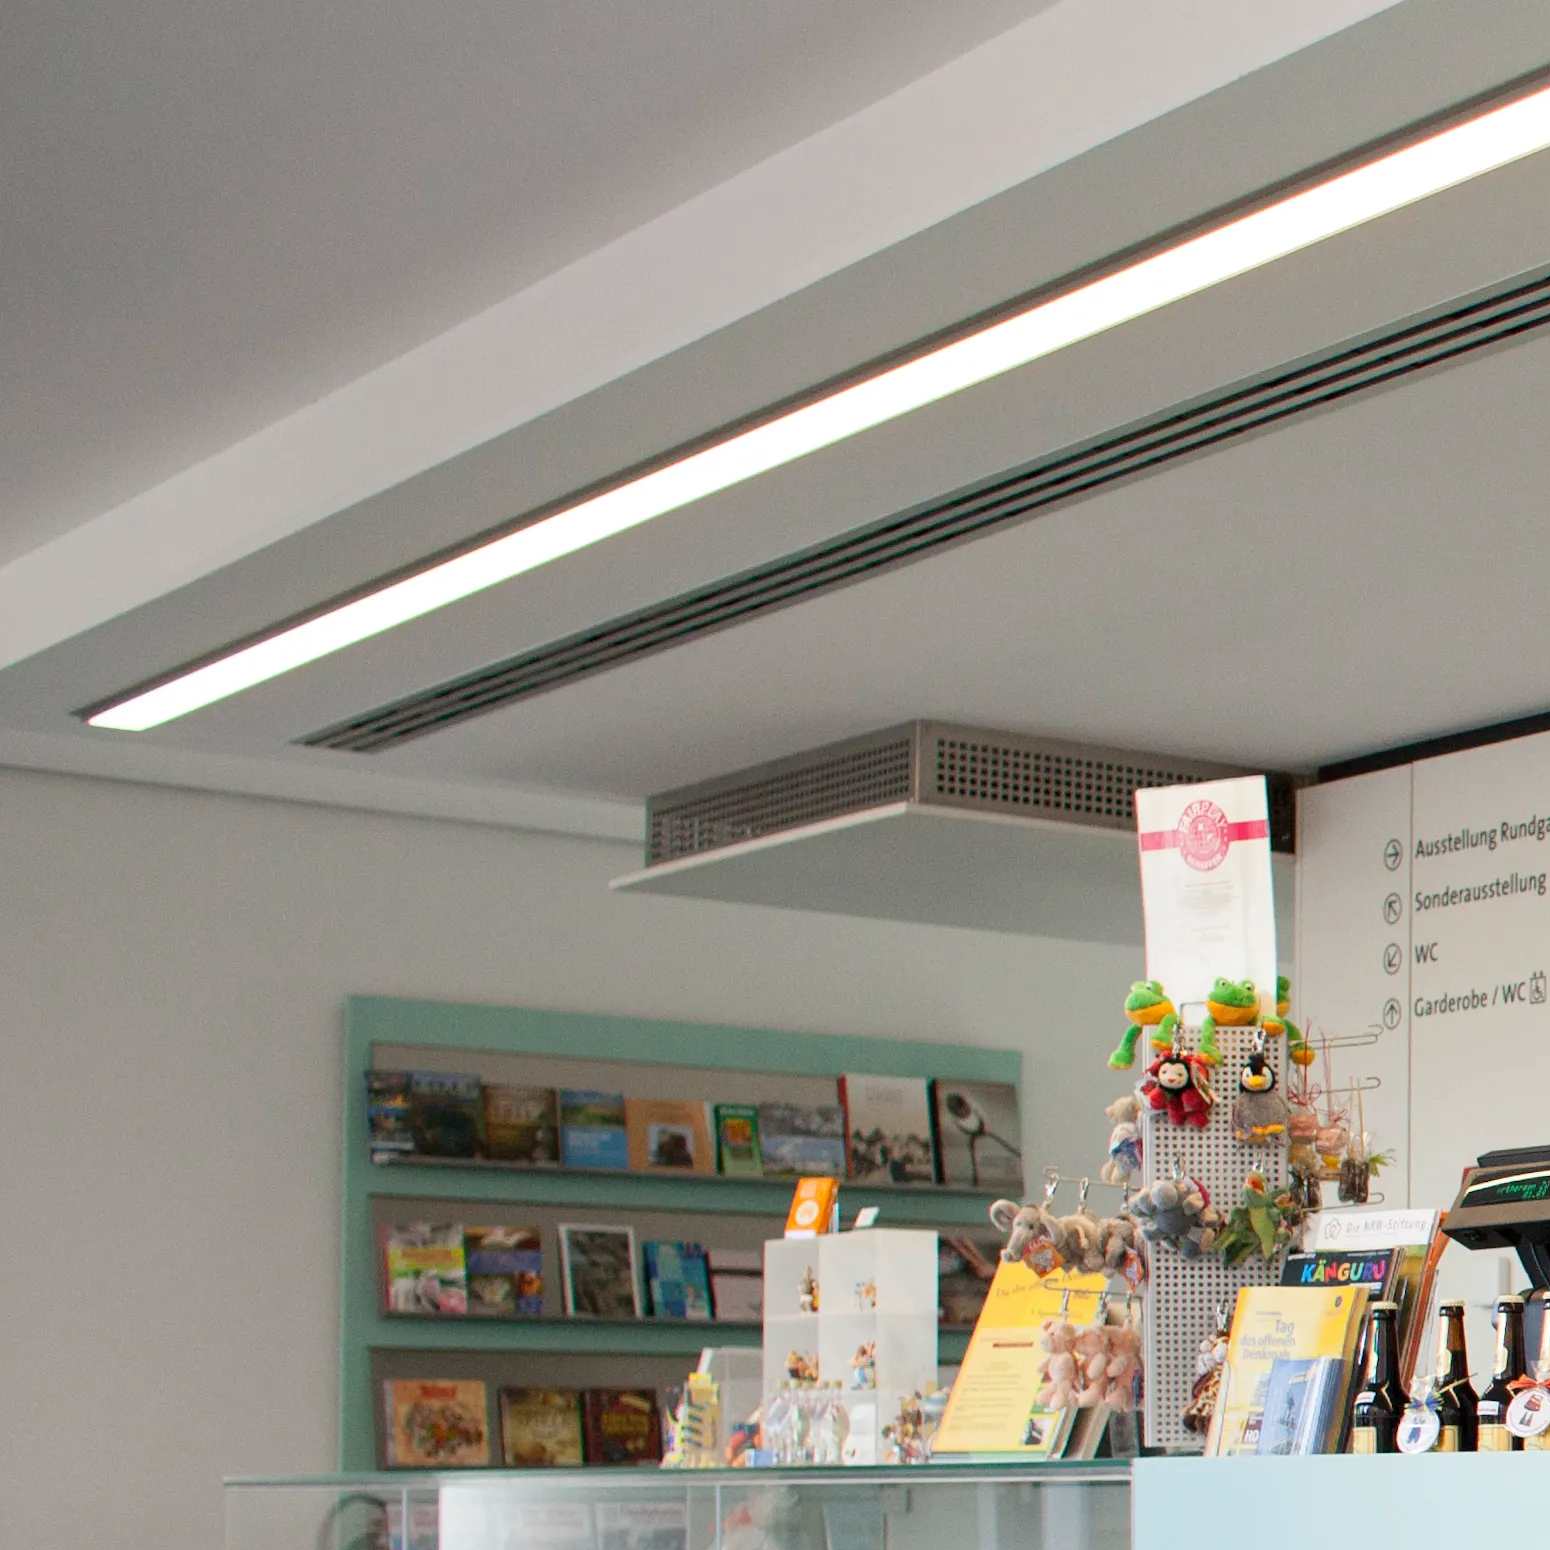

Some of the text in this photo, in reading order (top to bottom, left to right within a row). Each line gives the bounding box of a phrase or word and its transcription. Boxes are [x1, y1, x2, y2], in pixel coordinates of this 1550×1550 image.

[1179, 801, 1229, 832] FAIRPLAY
[1415, 829, 1497, 859] Ausstellung
[1415, 873, 1547, 912] Sonderausstellung
[1415, 943, 1438, 964] WC
[1414, 983, 1526, 1018] Garderobe / WC
[1346, 1218, 1428, 1233] Die NRW-Stiftung
[1301, 1259, 1387, 1283] KÄNGURU
[1240, 1331, 1296, 1346] des offenen
[1275, 1320, 1295, 1334] Tag
